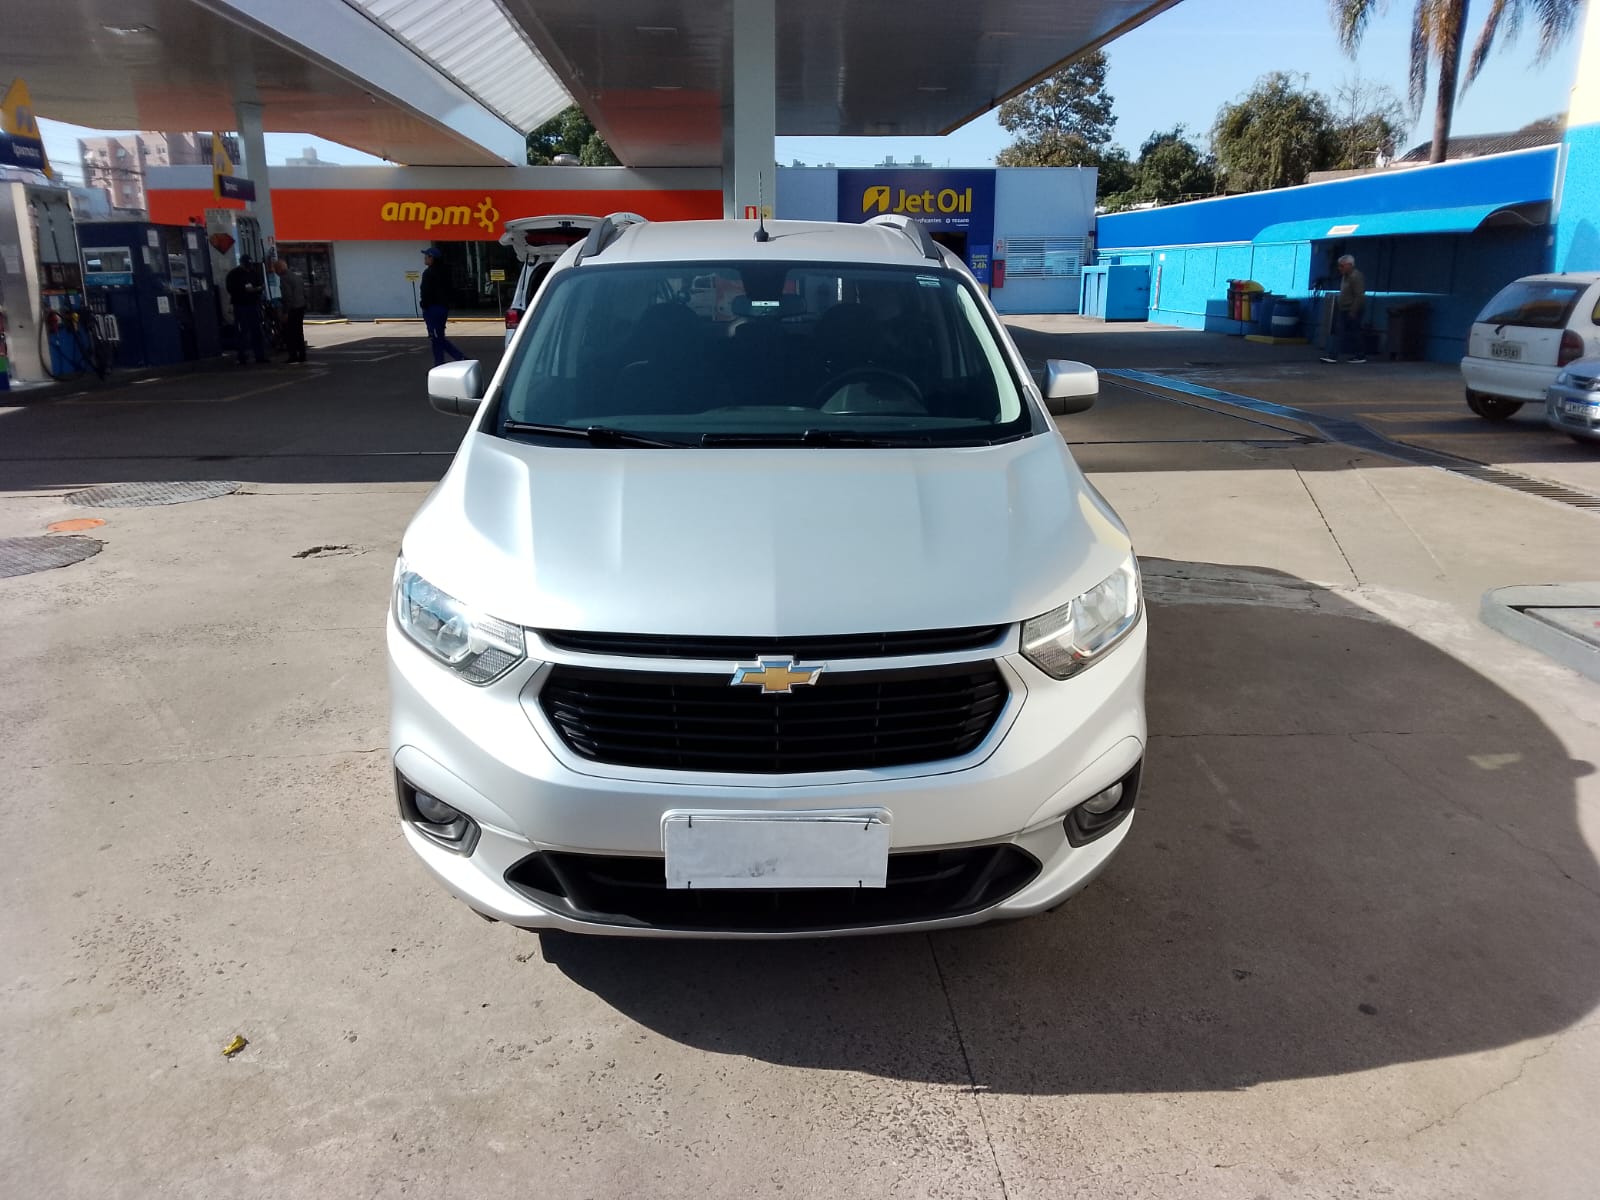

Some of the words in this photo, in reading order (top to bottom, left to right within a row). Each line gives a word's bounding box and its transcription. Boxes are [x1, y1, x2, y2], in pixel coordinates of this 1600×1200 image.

[893, 189, 935, 213] Jet
[937, 188, 972, 213] Oil
[381, 202, 471, 230] ampm
